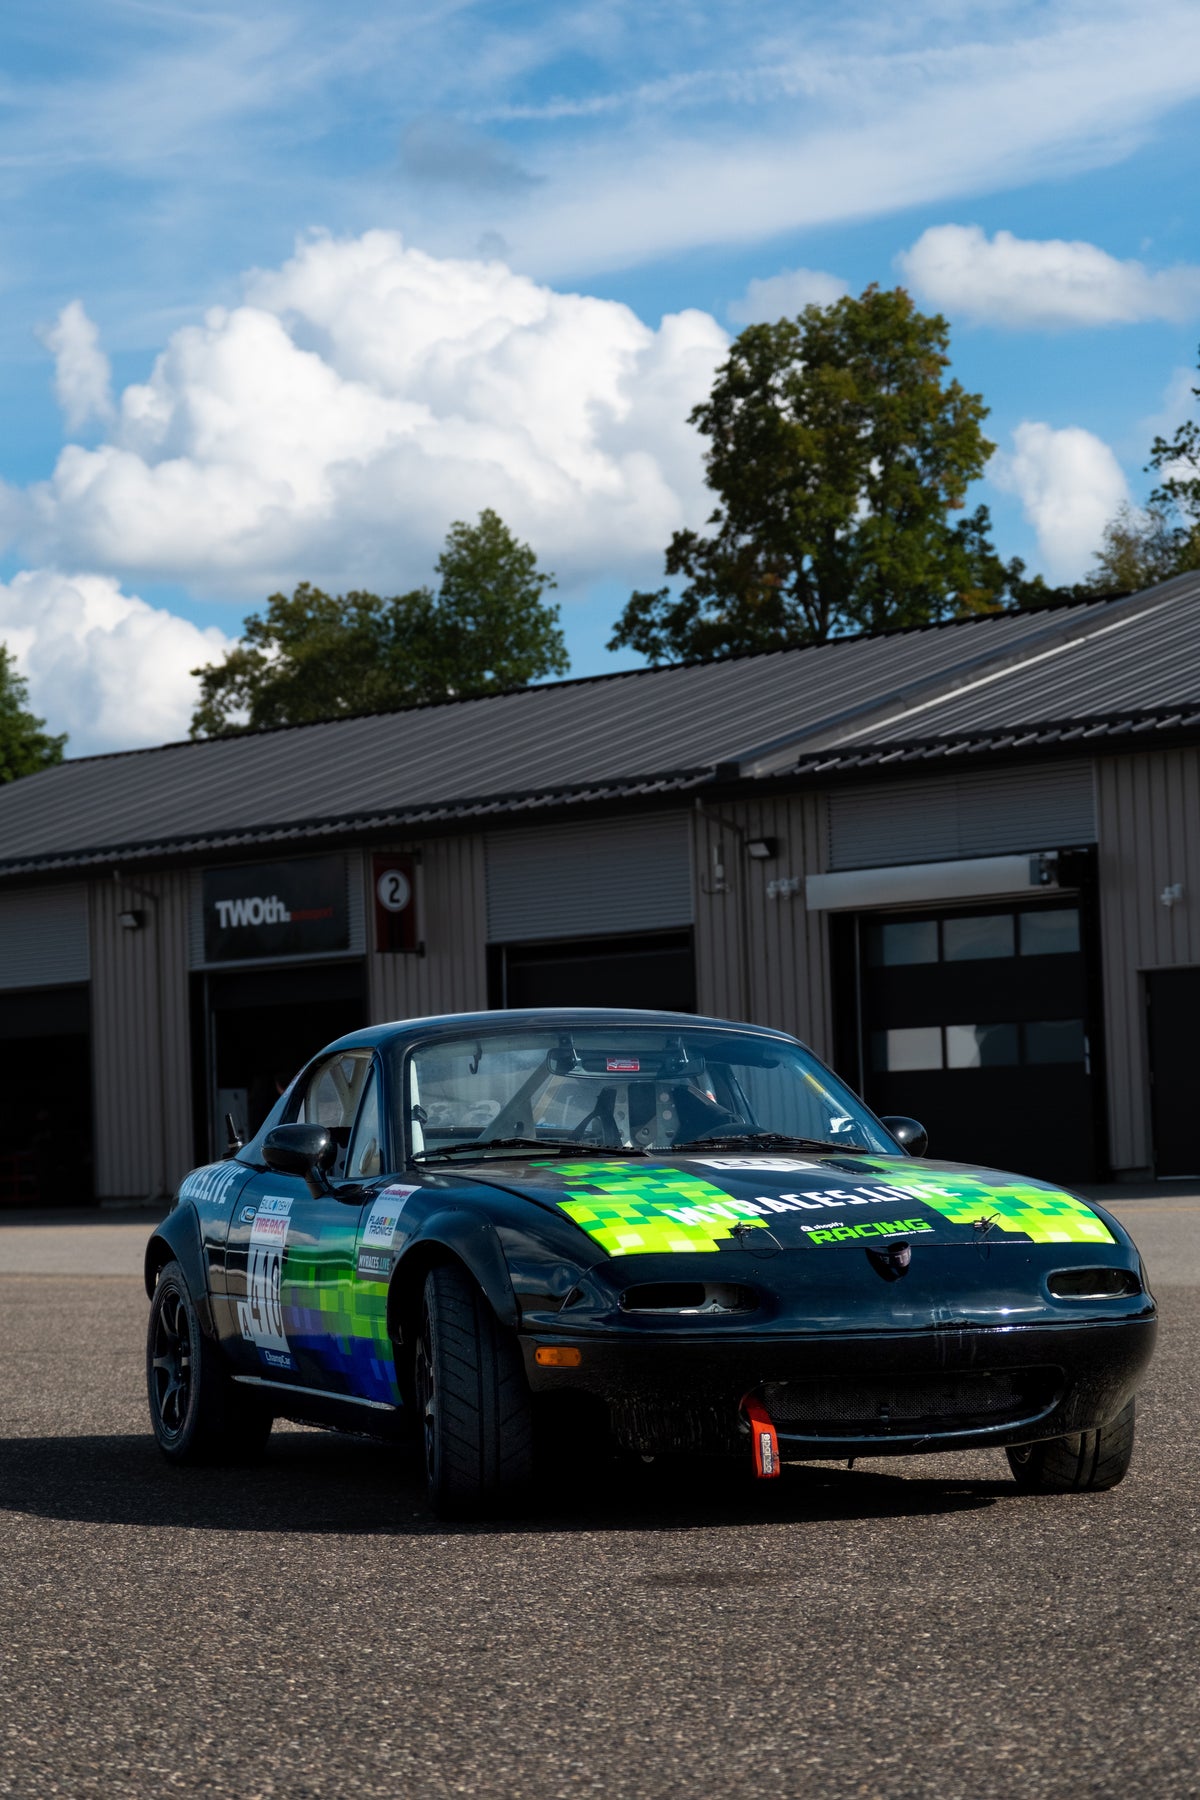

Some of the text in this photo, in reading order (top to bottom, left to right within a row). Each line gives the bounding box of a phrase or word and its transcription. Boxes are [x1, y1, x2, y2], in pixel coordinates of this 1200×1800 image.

[388, 876, 401, 904] 2
[661, 1184, 962, 1226] MYRACES.LIVE
[368, 1215, 385, 1226] FLAG
[368, 1225, 393, 1237] TRONICS
[806, 1218, 932, 1245] RACING
[813, 1222, 844, 1231] shopify
[242, 1307, 252, 1337] A
